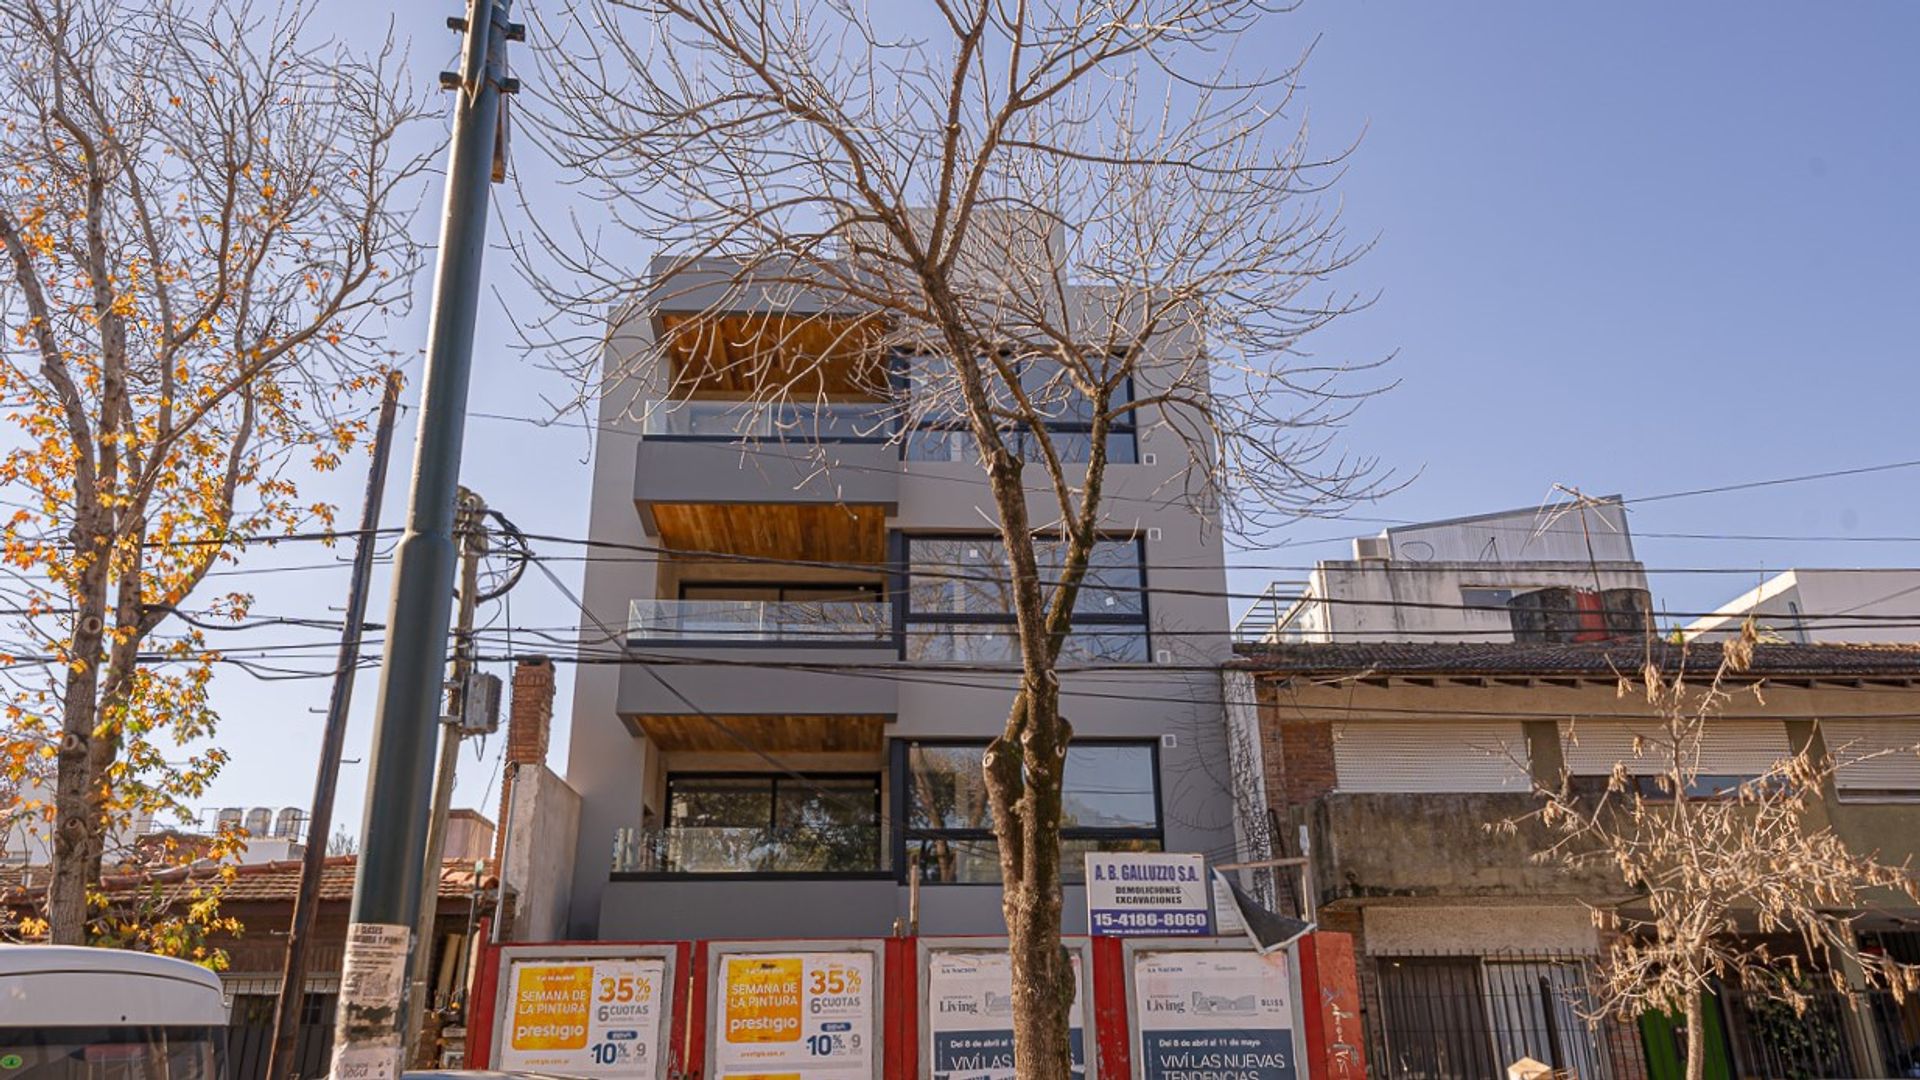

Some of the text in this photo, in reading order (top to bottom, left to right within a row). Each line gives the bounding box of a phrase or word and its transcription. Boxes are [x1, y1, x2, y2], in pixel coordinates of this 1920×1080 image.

[1121, 865, 1176, 881] GALLUZZO
[1178, 865, 1199, 882] S.A.
[1115, 886, 1182, 894] DEMOLICIONES
[1115, 896, 1182, 905] EXCAVACIONES
[1094, 913, 1207, 927] 15-4186-8060
[521, 989, 587, 1001] SEMANA DE
[732, 982, 797, 994] SEMANA DE
[519, 1003, 586, 1014] LA PINTURA
[731, 995, 798, 1008] LA PINTURA
[810, 997, 860, 1014] 6 CUOTAS
[939, 1000, 978, 1014] Living
[1146, 1000, 1185, 1013] Living
[598, 1004, 649, 1021] 6 CUOTAS
[517, 1024, 584, 1040] prestigio
[731, 1017, 798, 1034] prestigio
[851, 1034, 861, 1049] 9
[950, 1040, 964, 1048] Del
[983, 1039, 999, 1047] abril
[1001, 1039, 1008, 1047] al
[1160, 1039, 1172, 1047] Del
[1173, 1039, 1179, 1047] 8
[1181, 1039, 1190, 1047] de
[1192, 1039, 1209, 1047] abril
[1210, 1039, 1217, 1047] al
[1219, 1039, 1228, 1047] 11
[1241, 1040, 1261, 1048] mayo
[636, 1042, 646, 1057] 9
[951, 1052, 1011, 1070] VIVÍ LAS
[1160, 1052, 1285, 1068] VIVÍ LAS NUEVAS
[1162, 1070, 1259, 1080] TENDENCIAS
